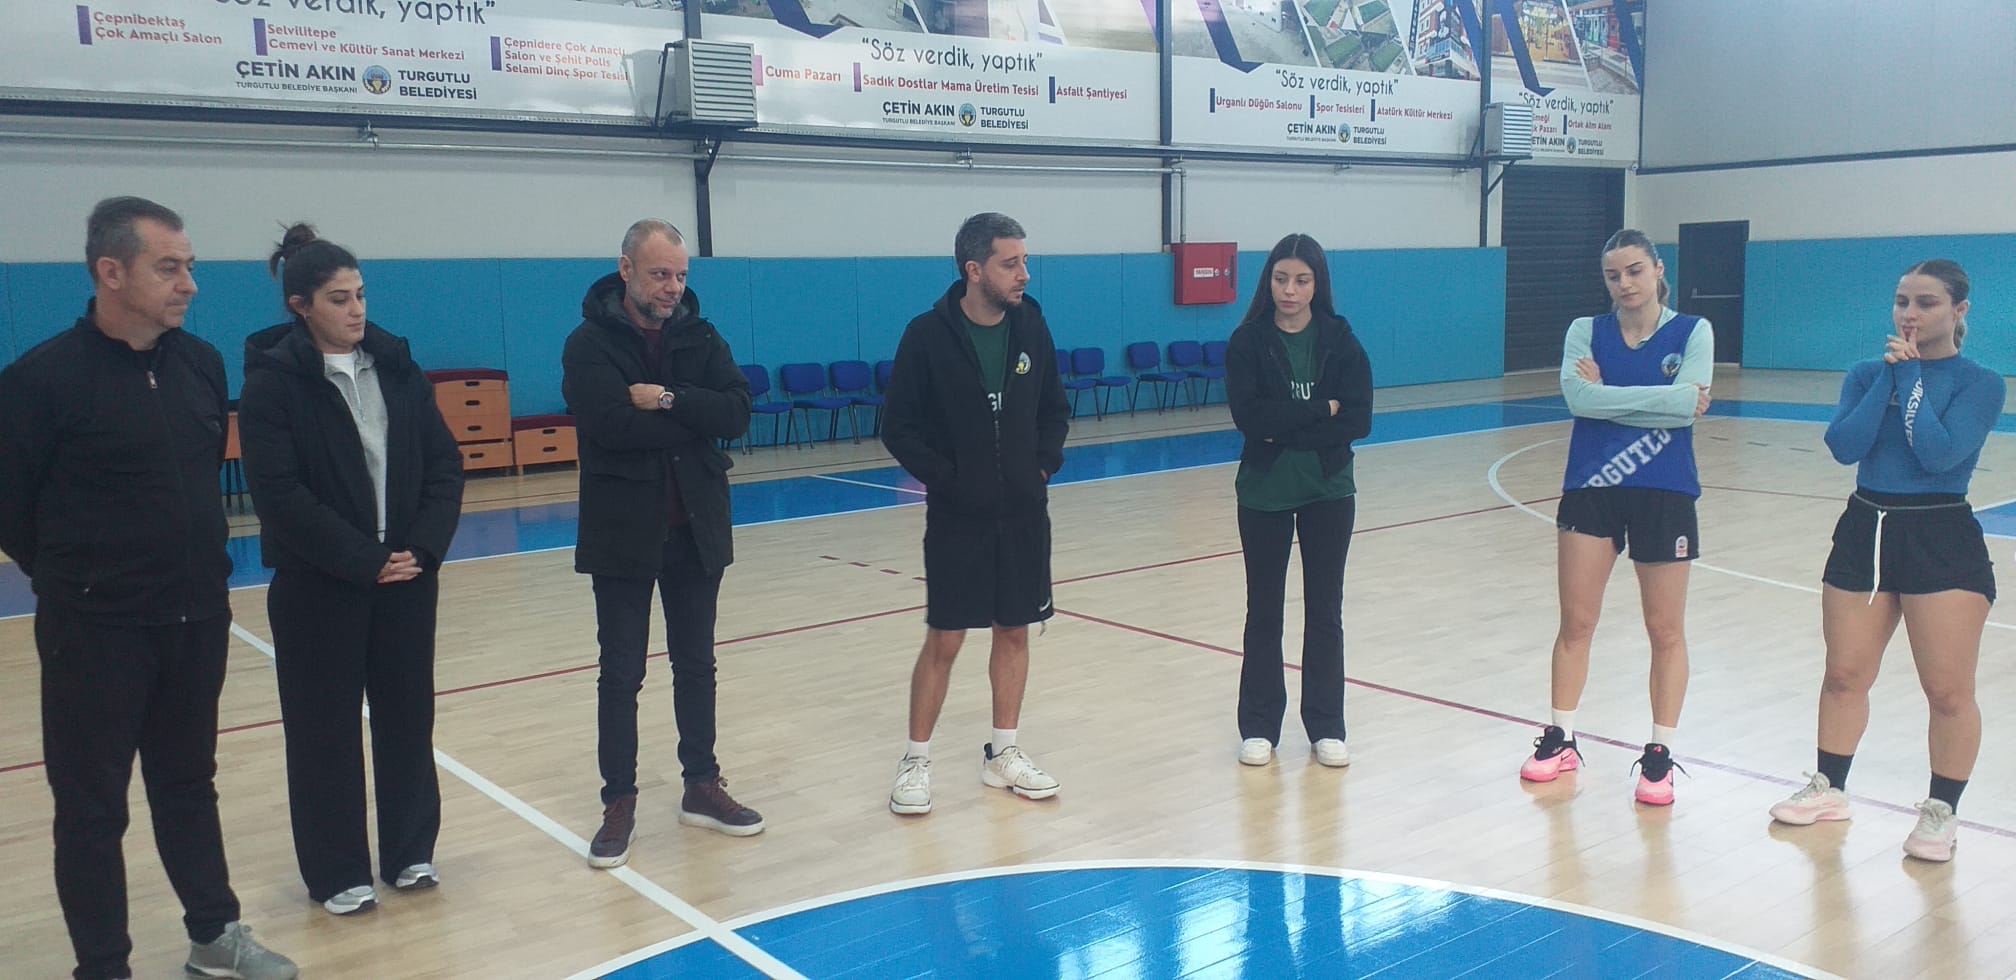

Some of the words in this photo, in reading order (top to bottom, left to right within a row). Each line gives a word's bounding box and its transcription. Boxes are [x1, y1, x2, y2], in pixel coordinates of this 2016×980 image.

[94, 11, 186, 29] Çepnibektaş
[95, 26, 125, 41] Çok
[130, 28, 179, 44] Amaçlı
[183, 32, 222, 45] Salon
[267, 23, 337, 40] Selvilitepe
[268, 38, 318, 52] Cemevi
[323, 44, 336, 53] ve
[340, 43, 378, 56] Kültür
[382, 46, 416, 58] Sanat
[419, 48, 465, 61] Merkezi
[504, 37, 562, 51] Çepnidere
[565, 42, 586, 55] Çok
[505, 50, 536, 62] Salon
[555, 54, 582, 66] Şehit
[585, 56, 611, 67] Polis
[914, 45, 975, 70] verdik,
[236, 59, 300, 79] ÇETİN
[306, 64, 356, 81] AKIN
[398, 70, 471, 84] TURGUTLU
[505, 64, 542, 75] Selami
[546, 66, 570, 79] Dinç
[573, 69, 598, 80] Spor
[765, 66, 801, 79] Cuma
[804, 69, 841, 82] Pazarı
[236, 81, 280, 90] TURGUTLU
[282, 83, 321, 92] BELEDİYE
[323, 85, 358, 94] BAŞKANI
[863, 74, 895, 88] Sadık
[898, 77, 938, 90] Dostlar
[941, 80, 972, 92] Mama
[975, 79, 1010, 95] Üretim
[1012, 84, 1039, 97] Tesisi
[1309, 74, 1352, 94] verdik,
[399, 85, 477, 100] BELEDİYESİ
[1057, 84, 1084, 97] Asfalt
[1086, 88, 1128, 101] Şantiyesi
[882, 100, 921, 115] ÇETİN
[924, 103, 955, 117] AKIN
[1216, 96, 1247, 109] Urganlı
[1248, 98, 1274, 110] Düğün
[1276, 100, 1303, 111] Salonu
[1316, 102, 1334, 114] Spor
[1335, 103, 1365, 114] Tesisleri
[1545, 95, 1577, 113] verdik,
[980, 107, 1025, 117] TURGUTLU
[1377, 106, 1403, 117] Atatürk
[1404, 107, 1425, 118] Kültür
[1427, 109, 1453, 120] Merkezi
[980, 119, 1029, 130] BELEDİYESİ
[1287, 121, 1313, 135] ÇETİN
[1315, 124, 1336, 135] AKIN
[1353, 126, 1385, 135] TURGUTLU
[1353, 136, 1387, 145] BELEDİYESİ
[1532, 135, 1547, 146] ETİN
[1548, 136, 1565, 147] AKIN
